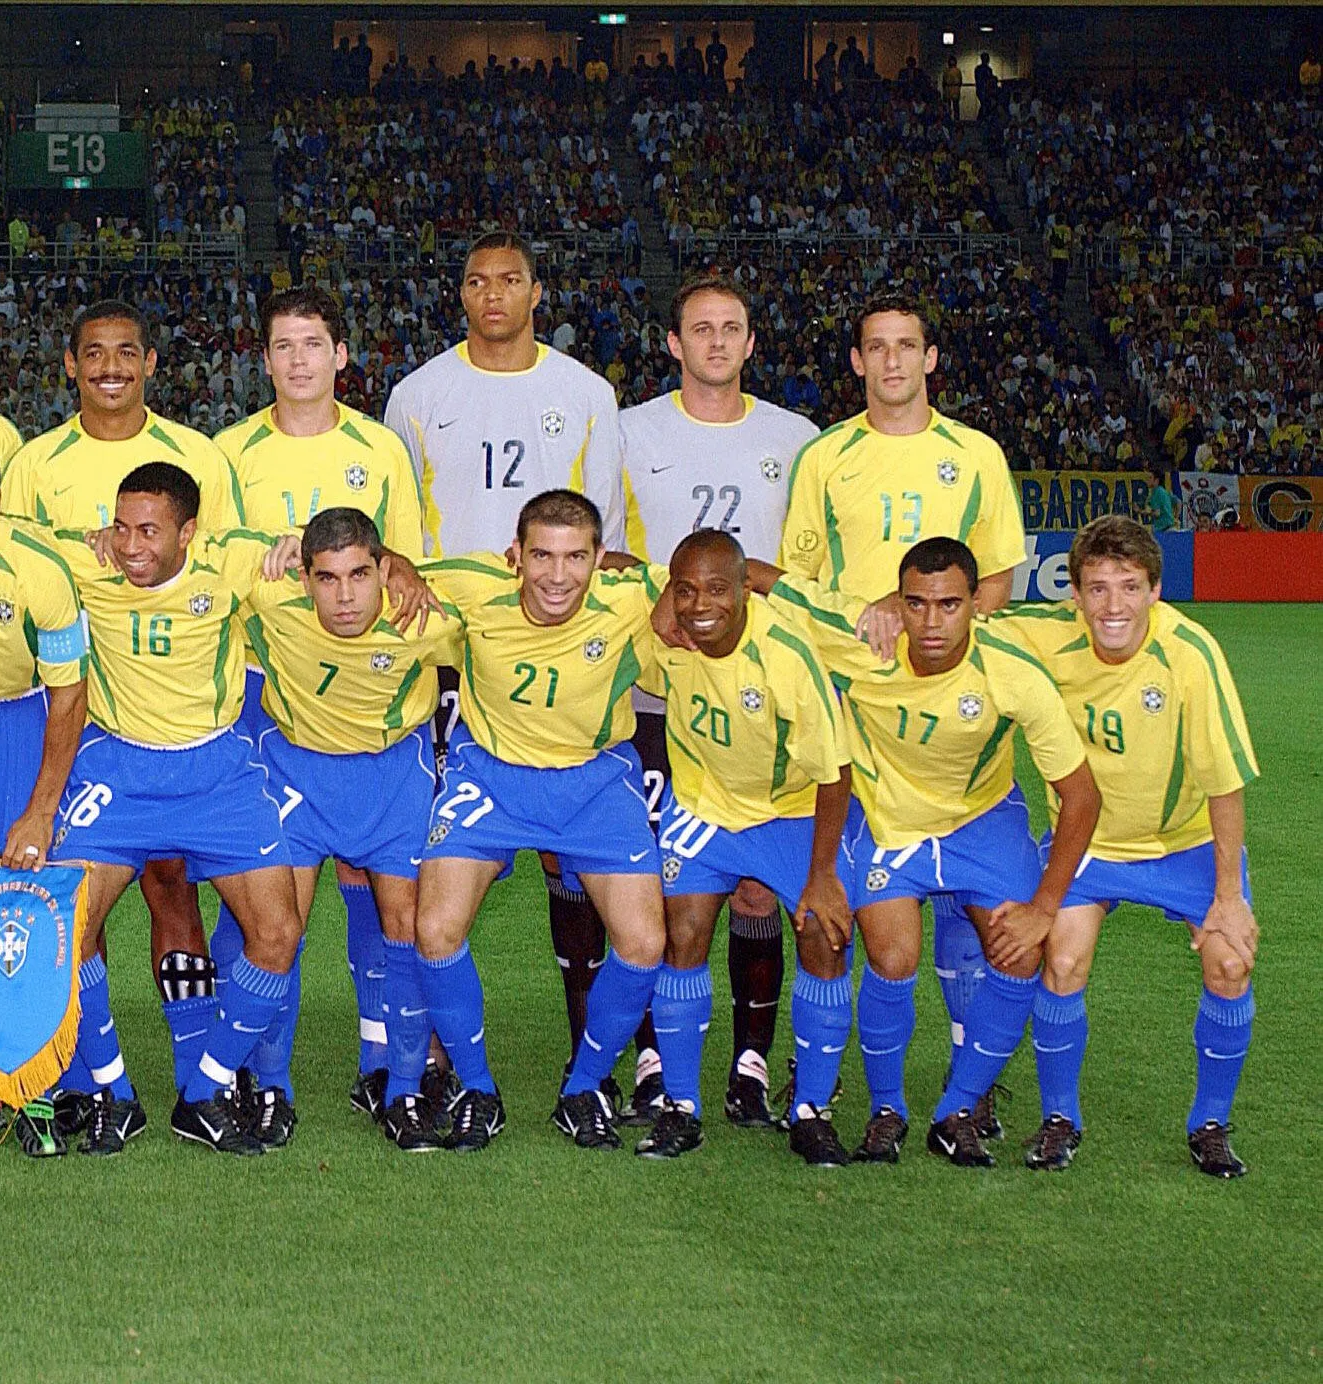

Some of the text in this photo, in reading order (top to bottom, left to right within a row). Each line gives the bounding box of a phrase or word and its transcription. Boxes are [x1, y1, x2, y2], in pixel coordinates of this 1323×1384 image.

[47, 133, 106, 173] E13
[481, 439, 525, 489] 12
[692, 484, 742, 534] 22
[879, 491, 923, 543] 13
[129, 609, 173, 657] 16
[315, 661, 339, 696] 7
[509, 661, 560, 709] 21
[691, 693, 732, 748] 20
[896, 704, 939, 745] 17
[1084, 703, 1125, 754] 19
[279, 784, 303, 822] 7
[438, 781, 495, 829] 21
[659, 805, 719, 859] 20
